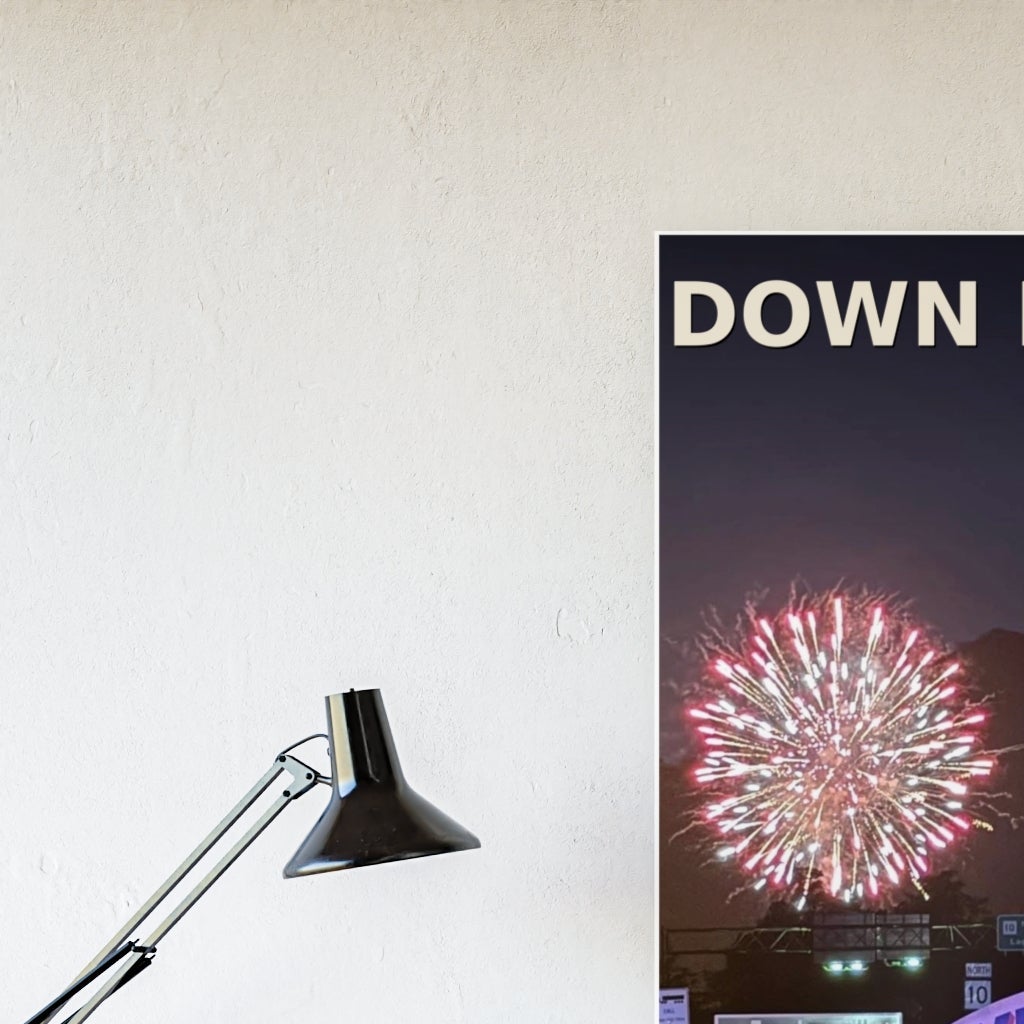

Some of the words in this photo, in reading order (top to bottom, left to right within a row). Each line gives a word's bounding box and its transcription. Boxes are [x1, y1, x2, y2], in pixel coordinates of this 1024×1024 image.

[674, 279, 978, 348] DOWN
[966, 966, 990, 975] NORTH
[968, 985, 989, 1005] 10
